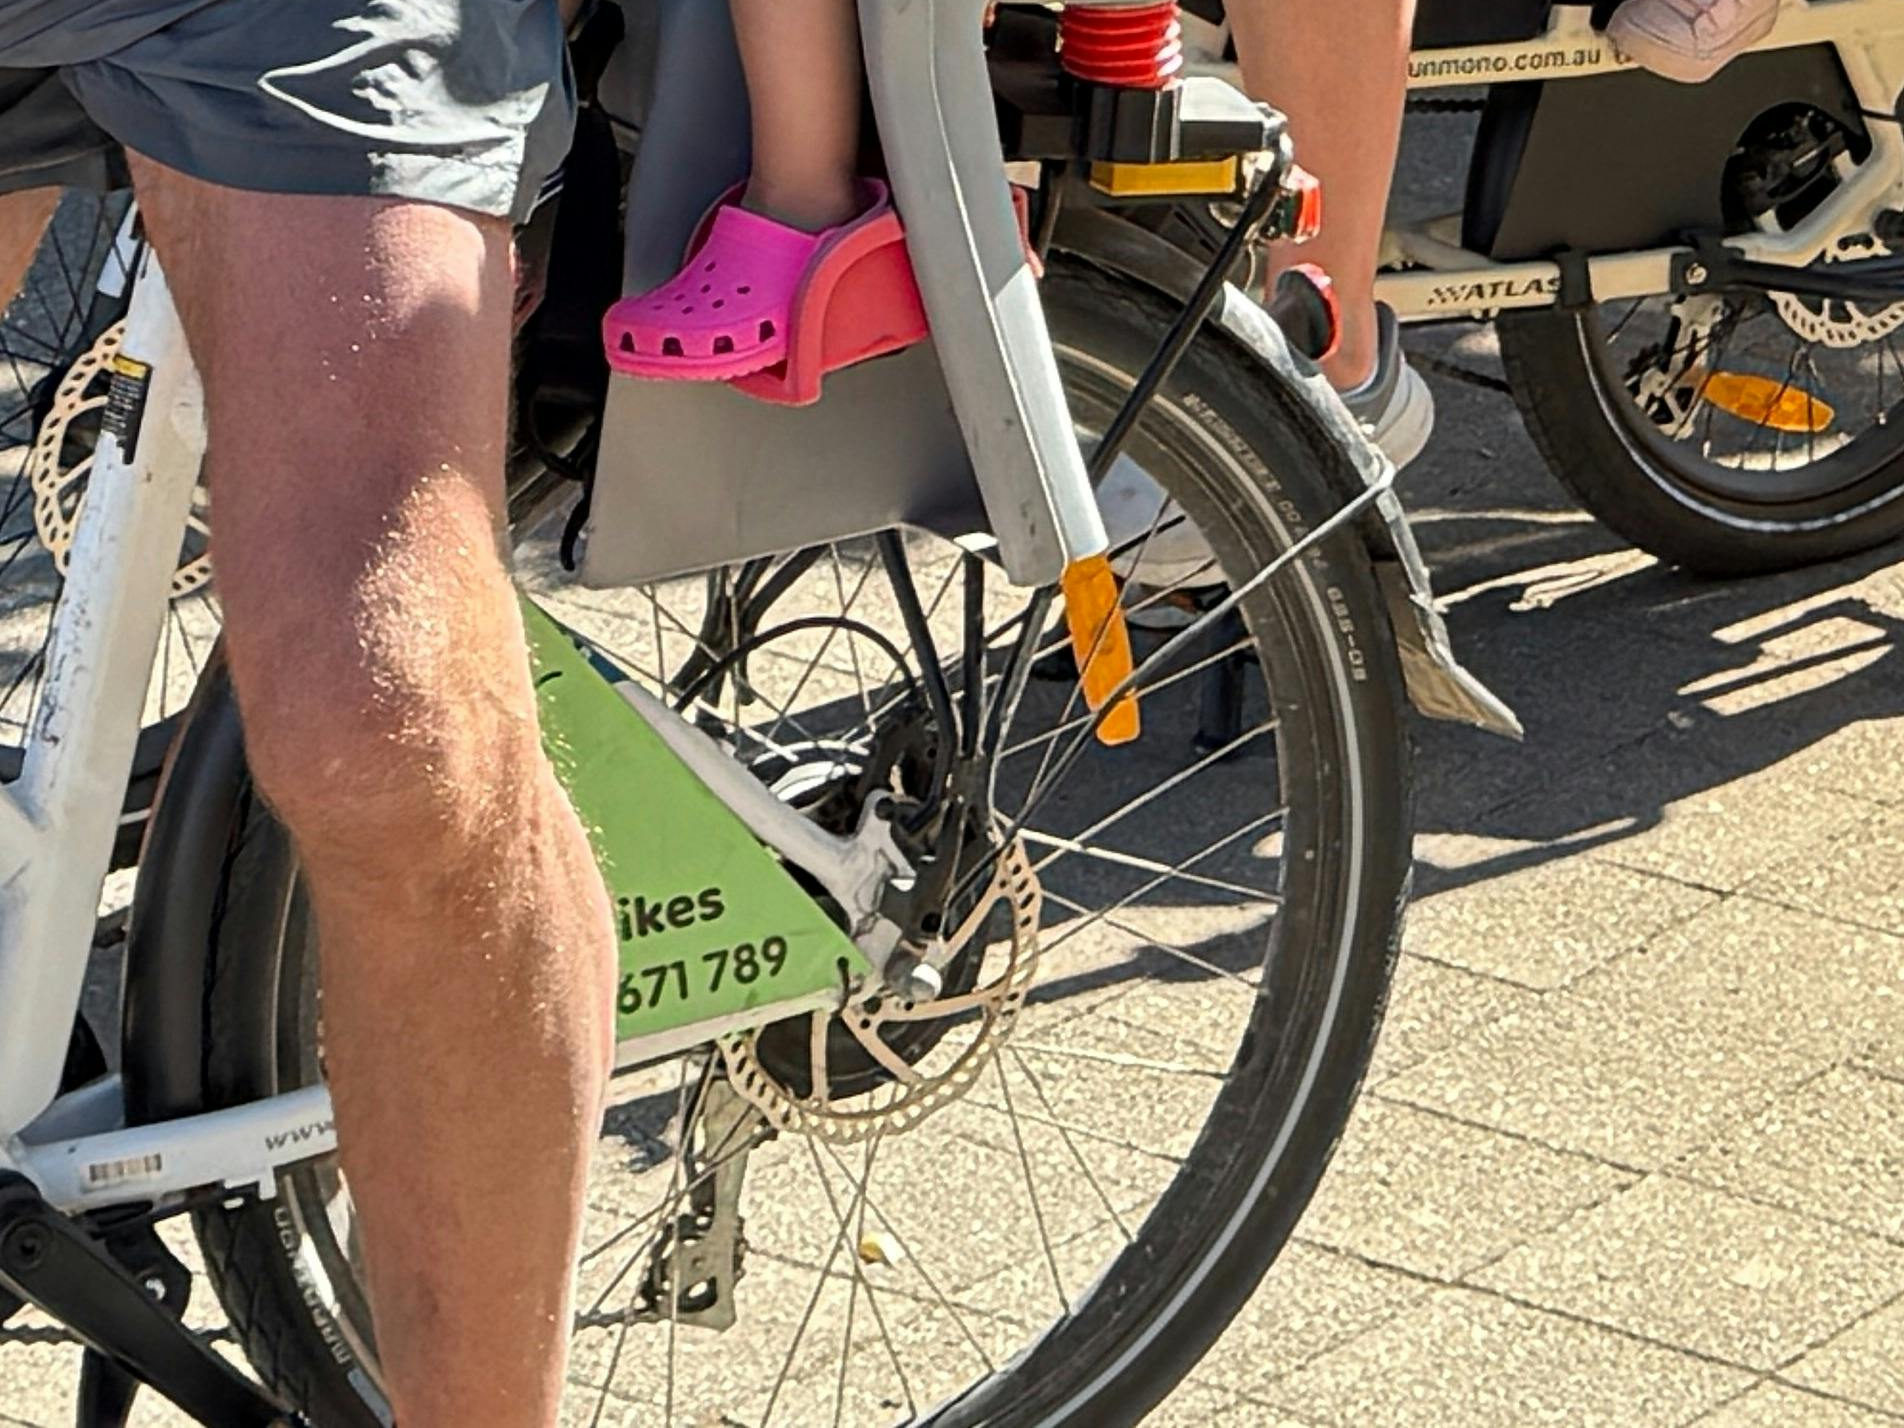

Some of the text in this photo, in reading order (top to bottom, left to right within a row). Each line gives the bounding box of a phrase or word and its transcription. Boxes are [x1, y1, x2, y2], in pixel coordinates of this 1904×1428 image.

[1407, 47, 1602, 78] unmono.com.au
[617, 888, 726, 941] ikes
[617, 935, 788, 1015] 671 789
